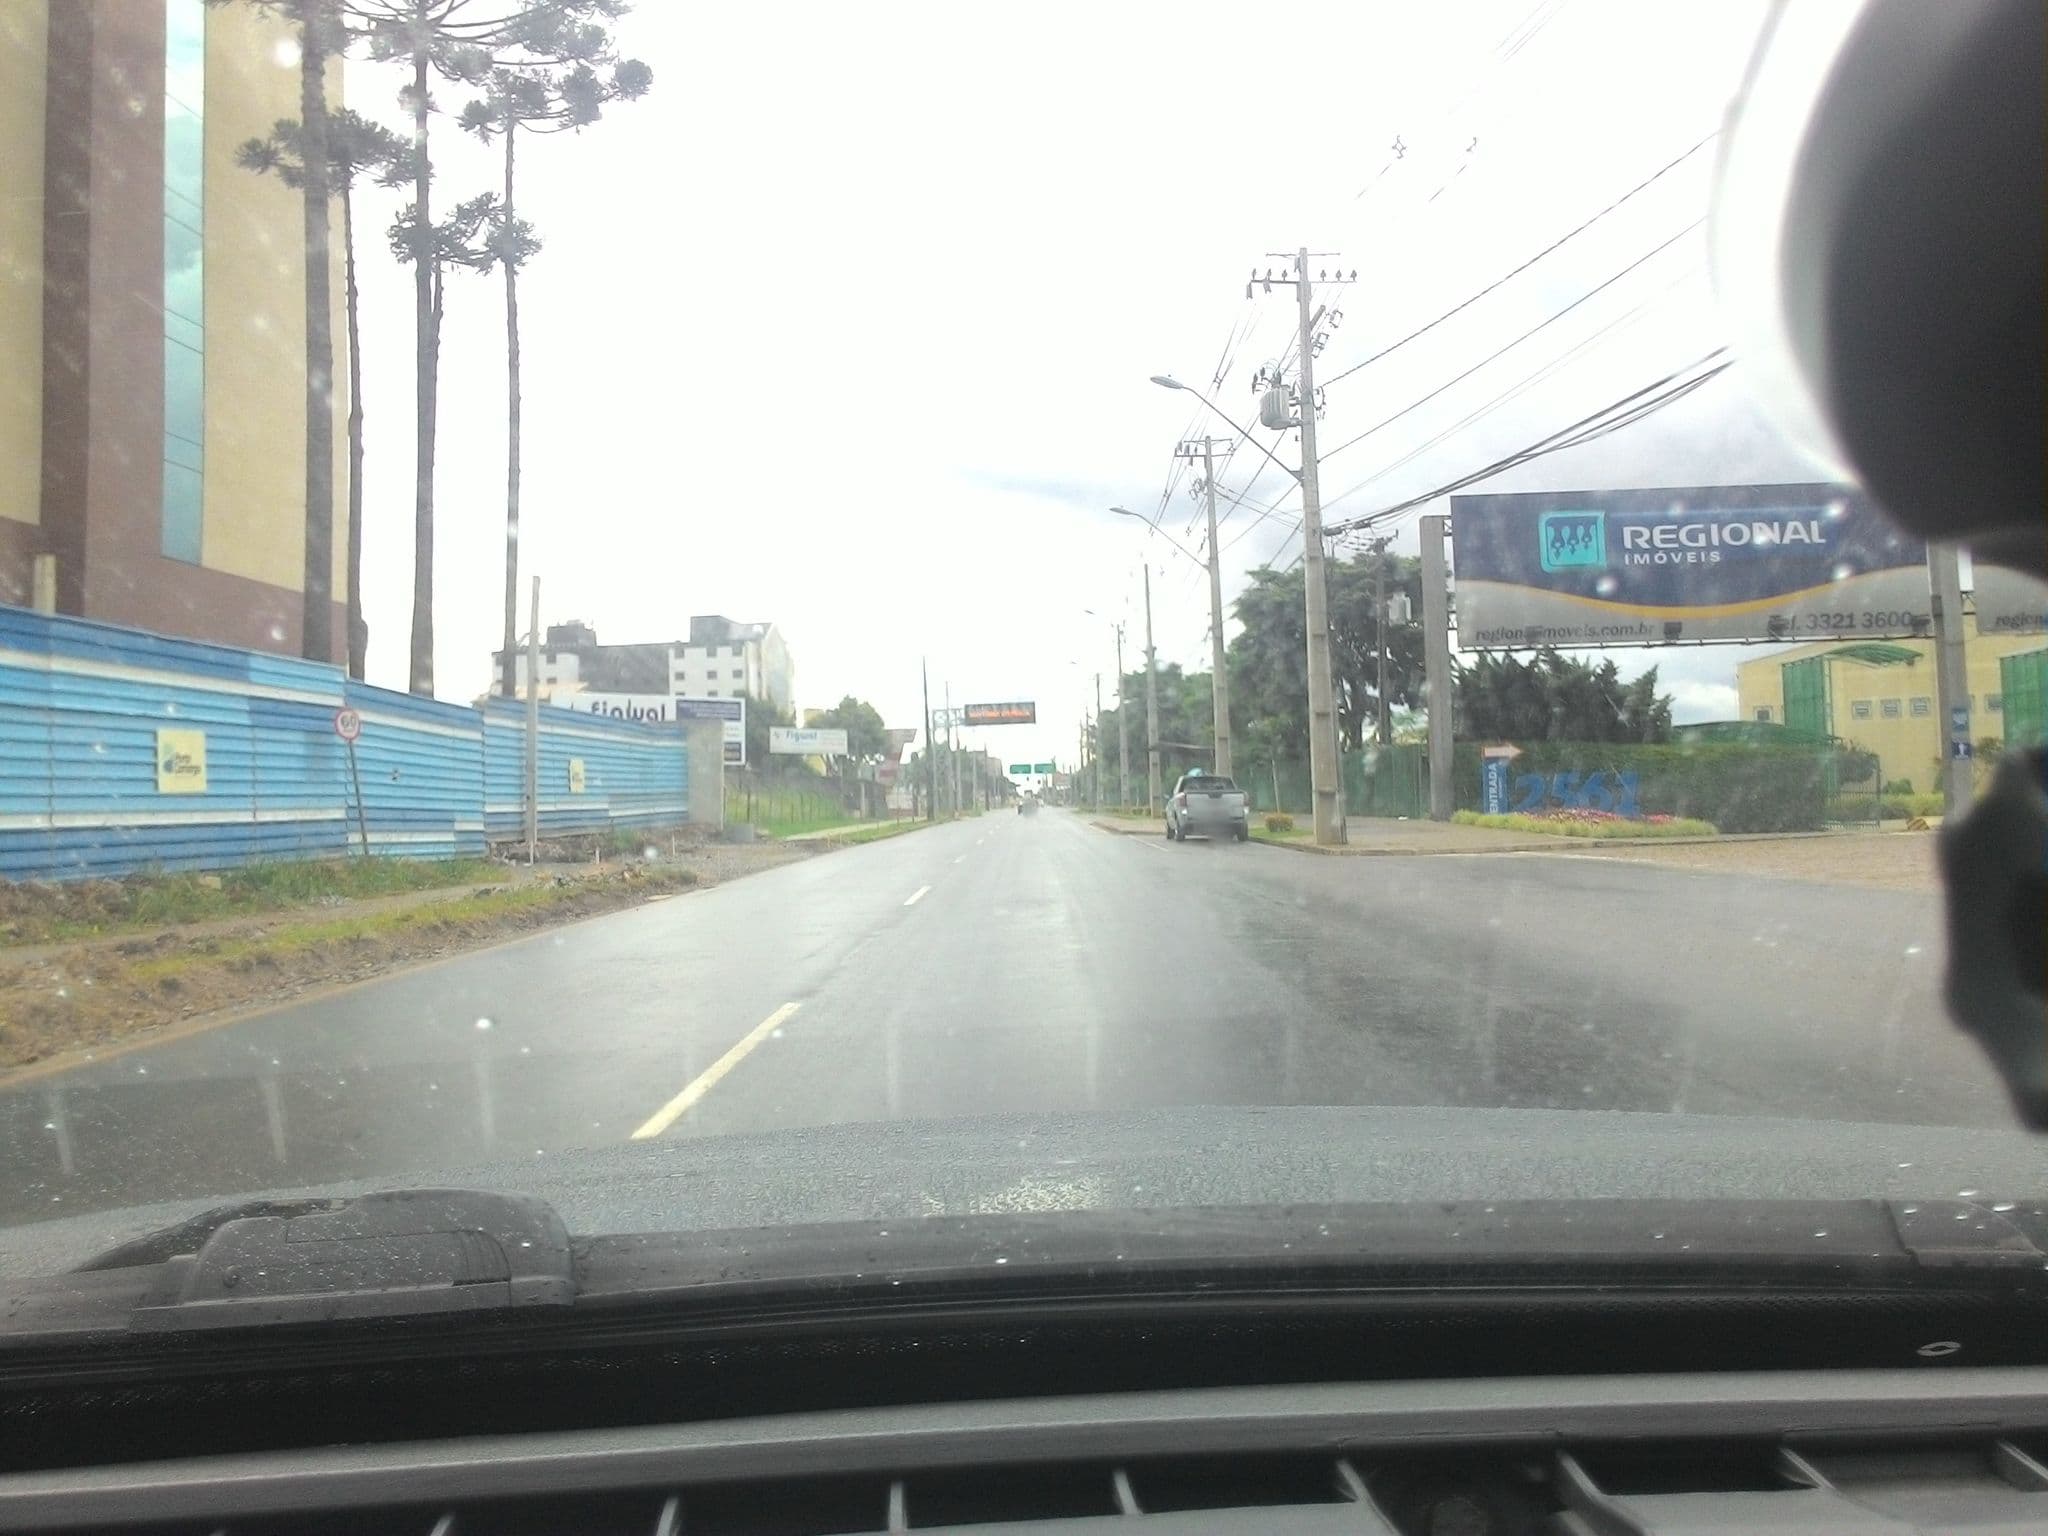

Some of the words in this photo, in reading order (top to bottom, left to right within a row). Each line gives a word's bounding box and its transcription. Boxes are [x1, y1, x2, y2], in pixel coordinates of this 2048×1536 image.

[1622, 520, 1827, 549] REGIONAL
[1624, 551, 1721, 565] IMÓVEIS
[1475, 621, 1654, 643] regionmoveis.com.br
[1806, 613, 1855, 631] 3321
[1861, 611, 1912, 629] 3600
[1488, 763, 1499, 814] ENTRADA
